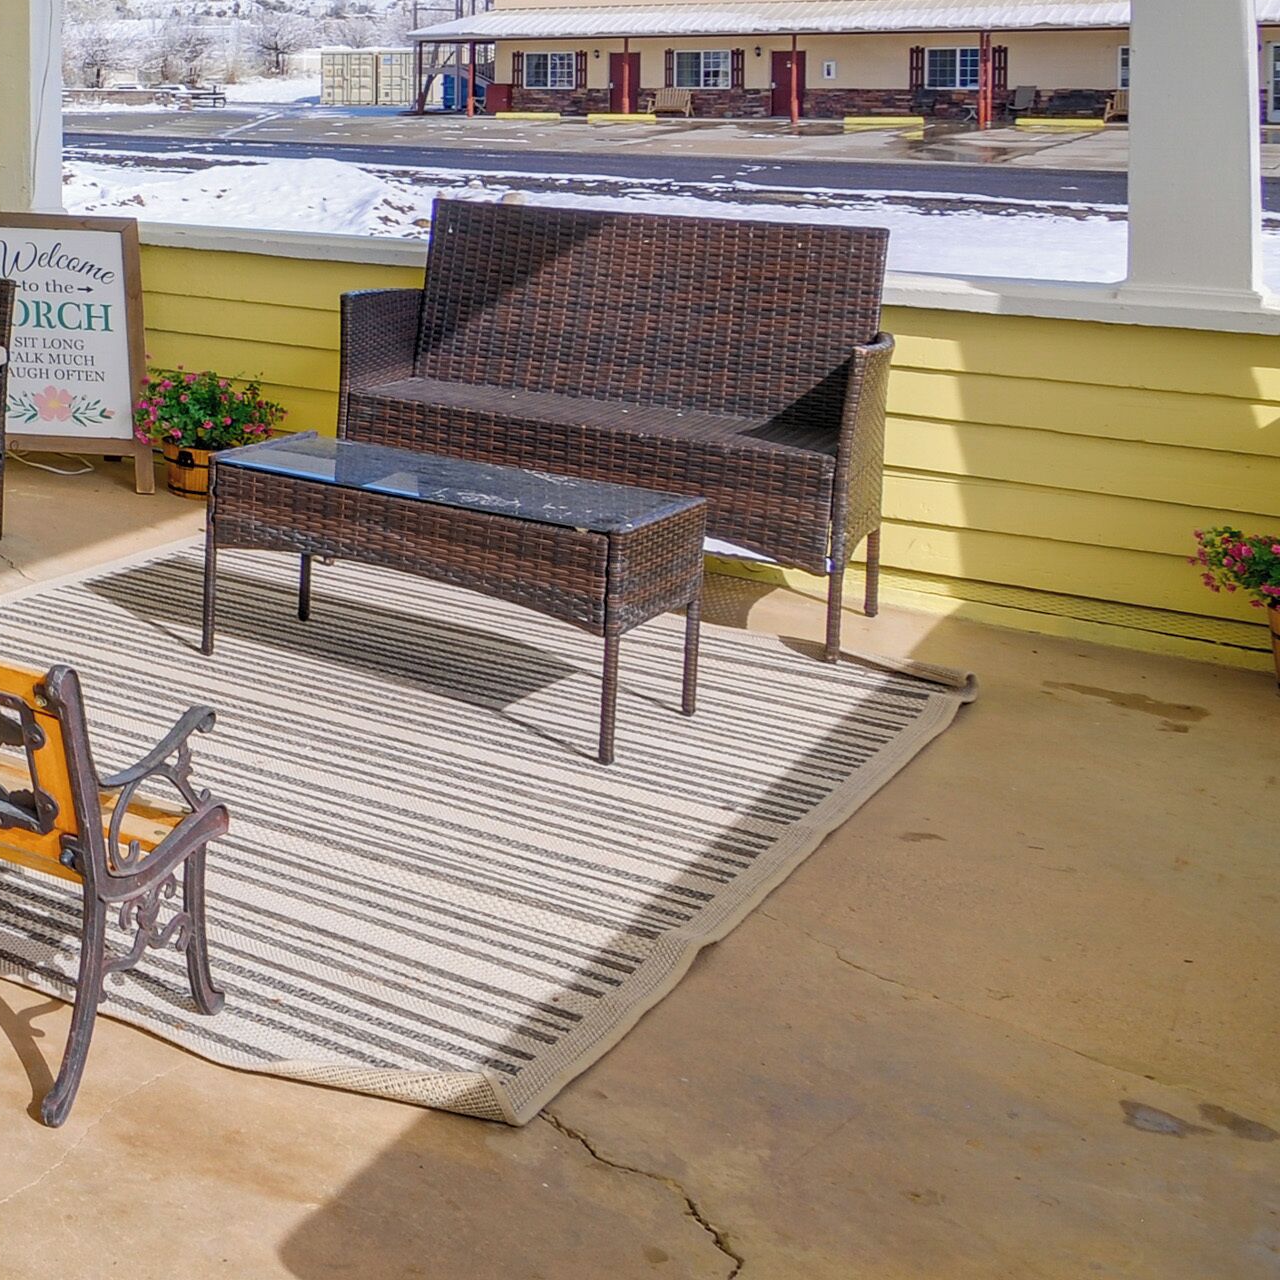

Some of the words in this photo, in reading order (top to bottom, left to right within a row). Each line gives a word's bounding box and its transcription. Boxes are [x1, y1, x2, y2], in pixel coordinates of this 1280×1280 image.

[21, 280, 40, 293] to
[45, 280, 75, 294] the
[12, 299, 114, 333] ORCH
[14, 336, 39, 349] SIT
[42, 338, 85, 351] LONG
[48, 353, 96, 367] MUCH
[53, 368, 106, 382] OFTEN
